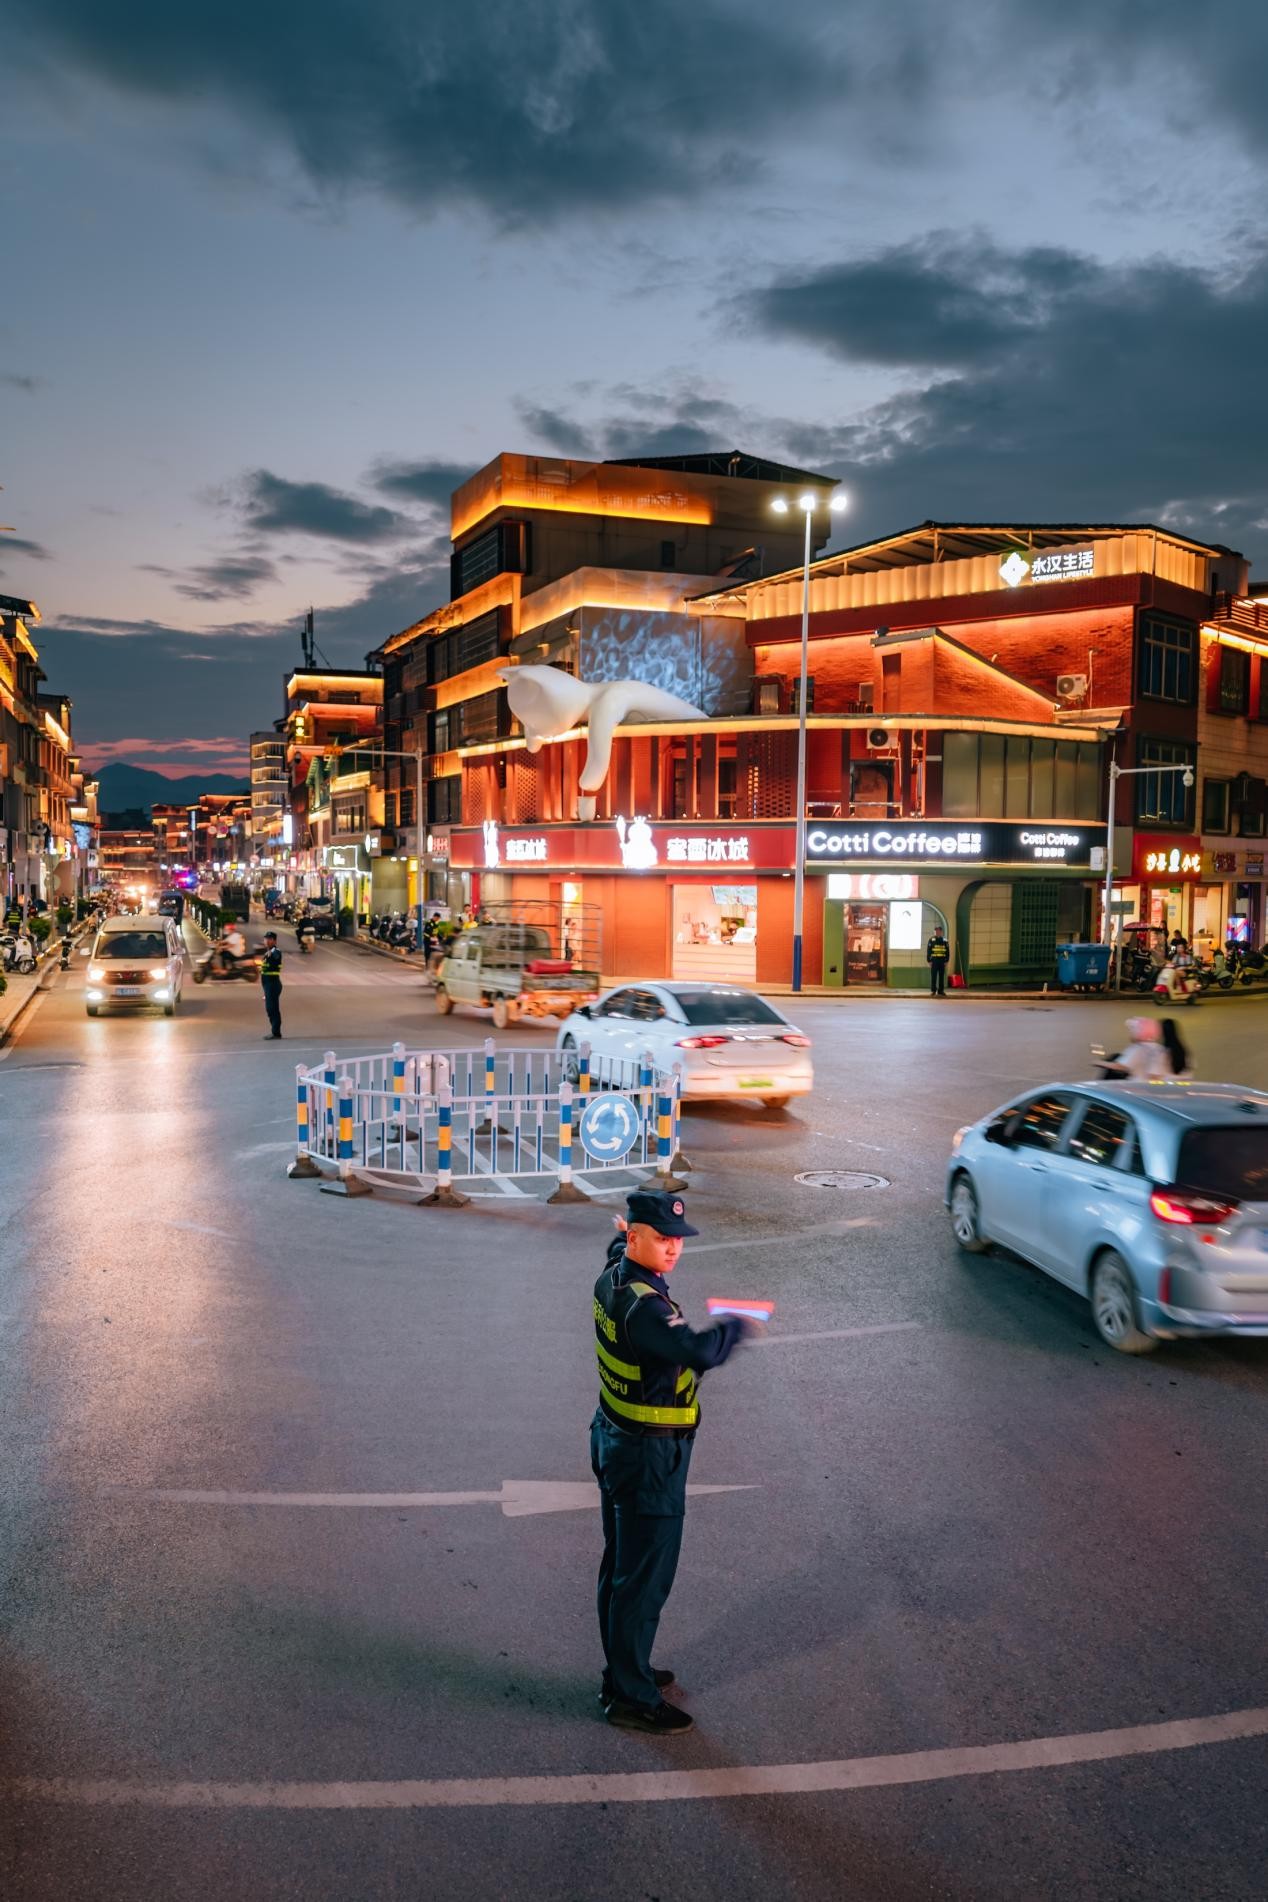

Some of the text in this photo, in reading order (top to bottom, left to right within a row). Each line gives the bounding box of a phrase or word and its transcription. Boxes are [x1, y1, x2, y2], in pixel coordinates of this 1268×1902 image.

[1032, 551, 1093, 575] 永汉生活
[667, 837, 749, 861] 蜜雪冰城
[808, 831, 869, 852] Cotti
[872, 832, 957, 853] Coffee
